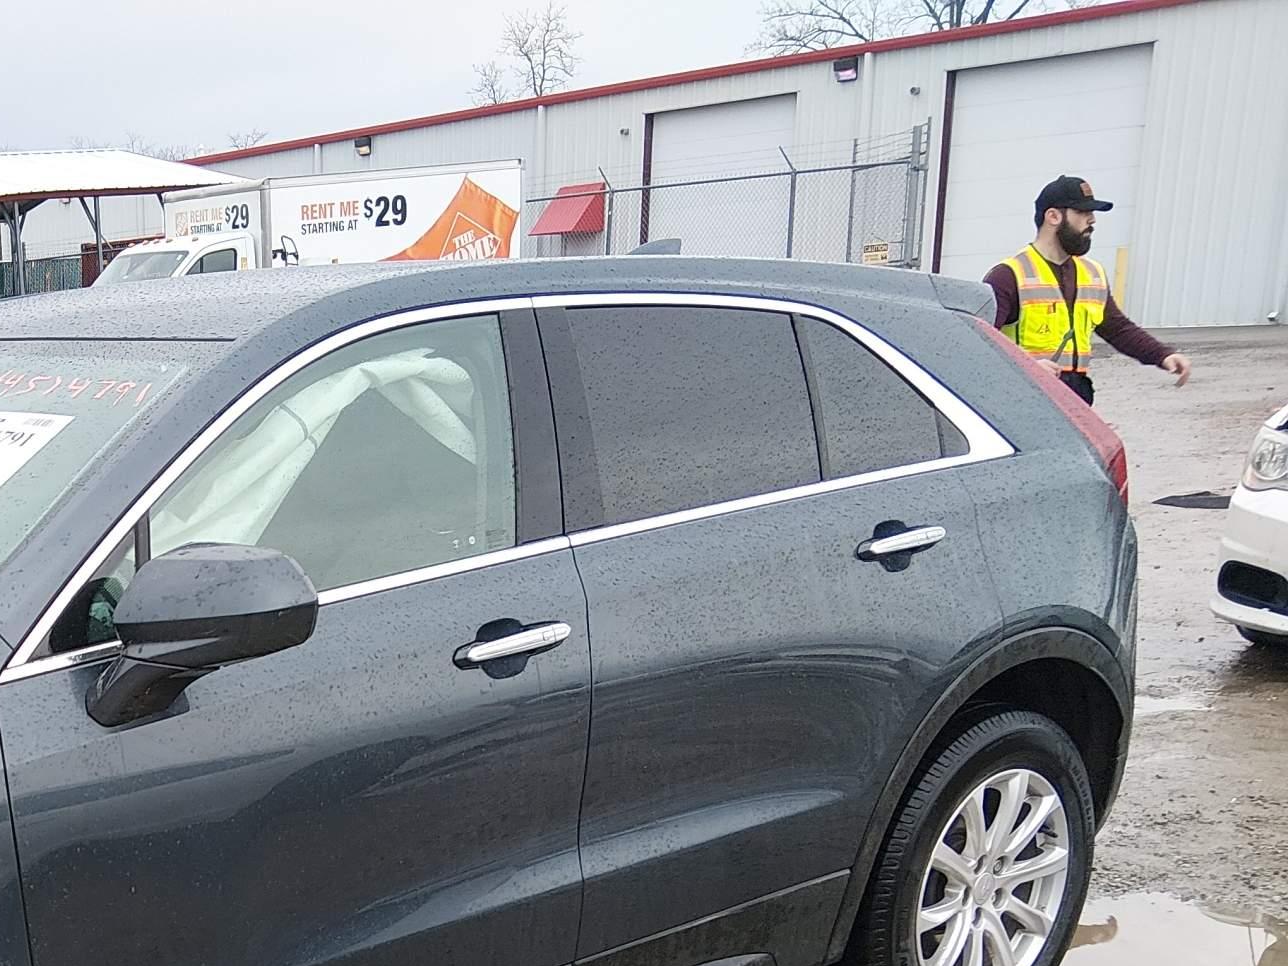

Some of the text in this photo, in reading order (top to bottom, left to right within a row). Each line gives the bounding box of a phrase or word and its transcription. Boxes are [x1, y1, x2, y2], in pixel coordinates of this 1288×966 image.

[225, 203, 249, 229] $29
[301, 200, 360, 221] RENT ME
[363, 194, 408, 227] $29
[190, 224, 215, 235] STARTING
[301, 219, 359, 235] STARTING AT
[452, 229, 475, 249] THE
